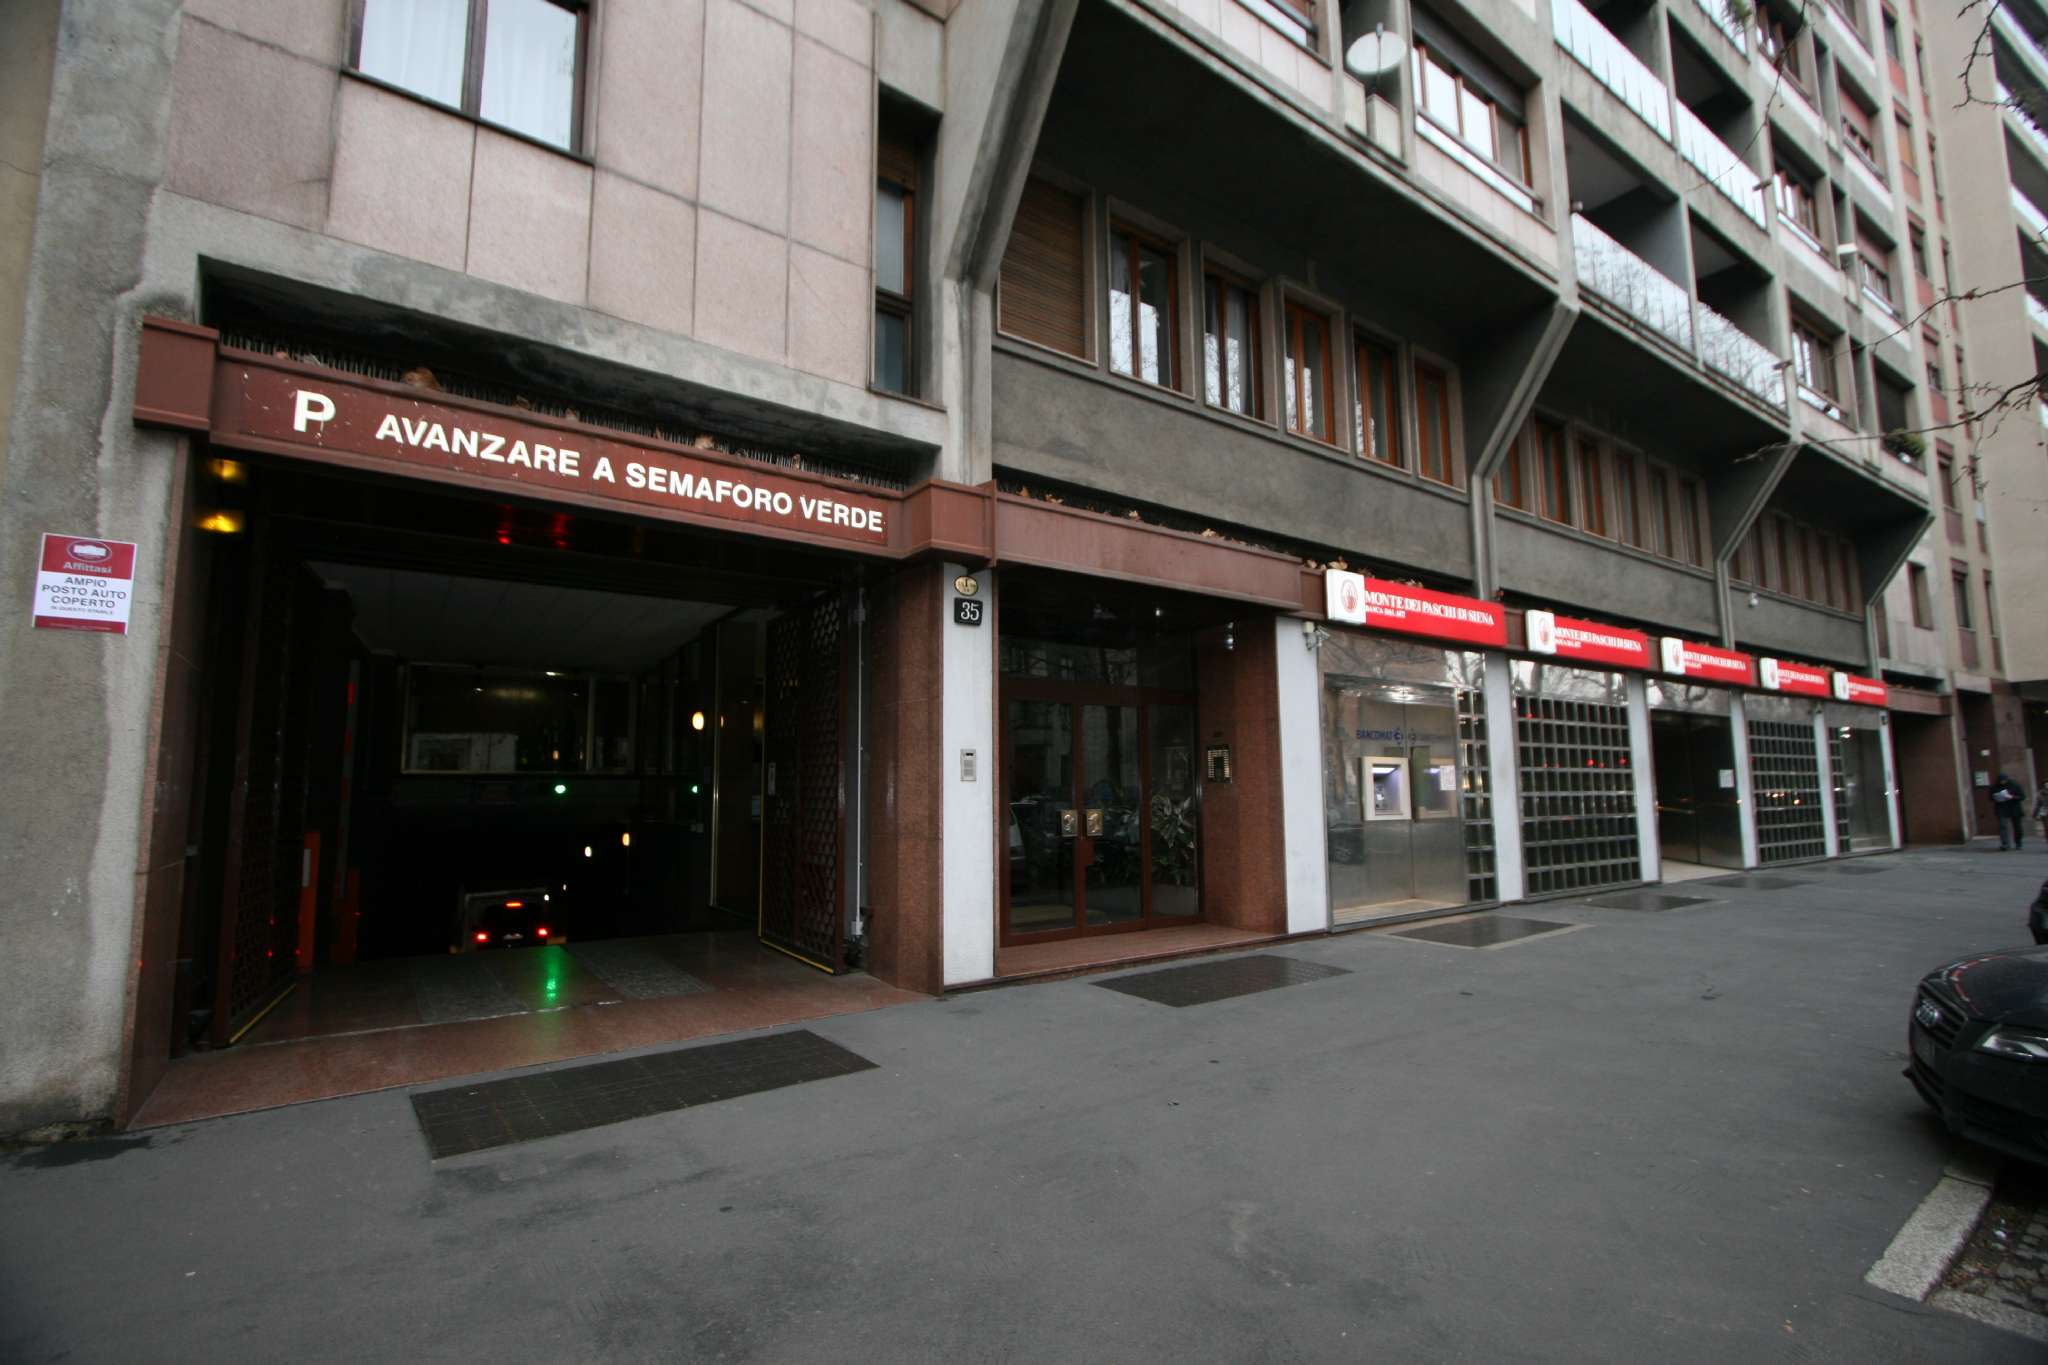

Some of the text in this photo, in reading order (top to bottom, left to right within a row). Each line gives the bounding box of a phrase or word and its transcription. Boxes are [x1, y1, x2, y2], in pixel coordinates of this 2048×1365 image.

[293, 389, 884, 533] P AVANZARE A SEMAFORO VERDE
[64, 576, 108, 588] AMPIO
[42, 584, 127, 600] POSTO AUTO
[51, 595, 116, 609] COPERTO
[960, 601, 980, 621] 35
[1365, 590, 1495, 626] MONTE DEI PASCHI DI SIENA
